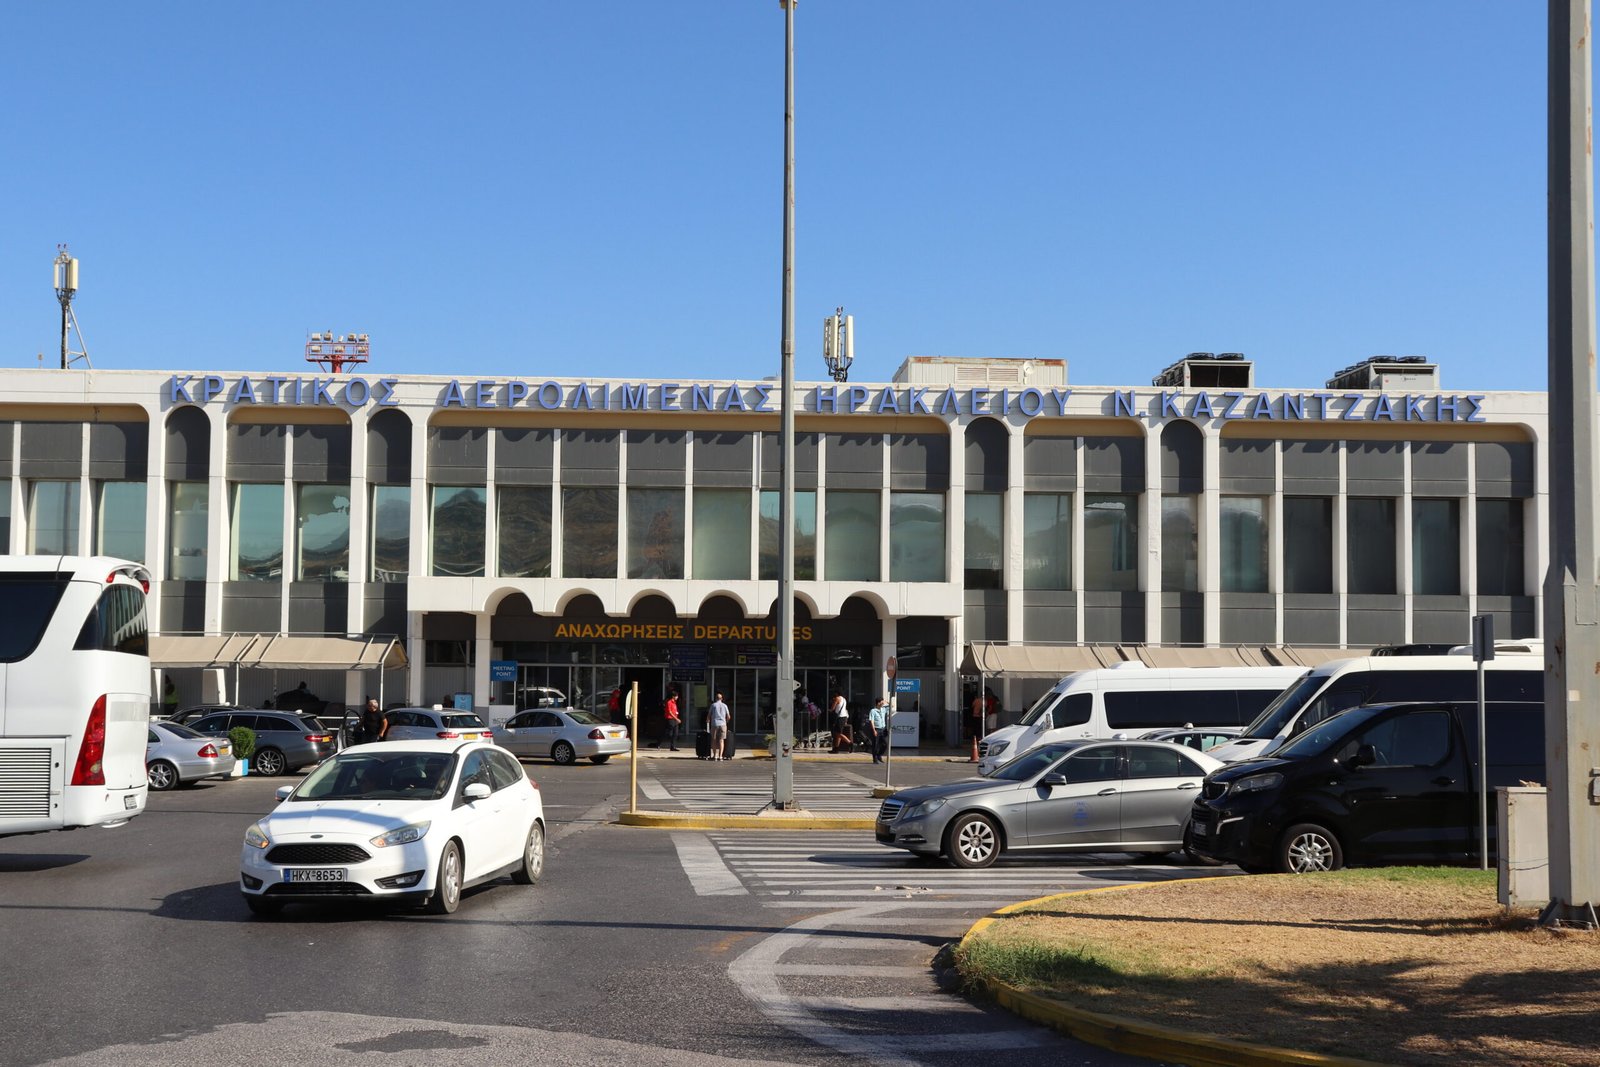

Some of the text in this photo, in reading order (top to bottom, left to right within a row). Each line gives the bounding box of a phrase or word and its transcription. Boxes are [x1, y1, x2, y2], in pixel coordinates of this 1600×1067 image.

[171, 374, 1487, 422] ΚΡΑΤΙΚΟΣ ΑΕΡΟΛΙΜΕΝΑΣ ΗΡΑΚΛΕΙΟΥ Ν. ΚΑΖΑΝΤΖΑΚΗΣ
[554, 623, 684, 640] ΑΝΑΧΩΡΗΣΕΙΣ
[694, 625, 813, 641] DEPARTUES
